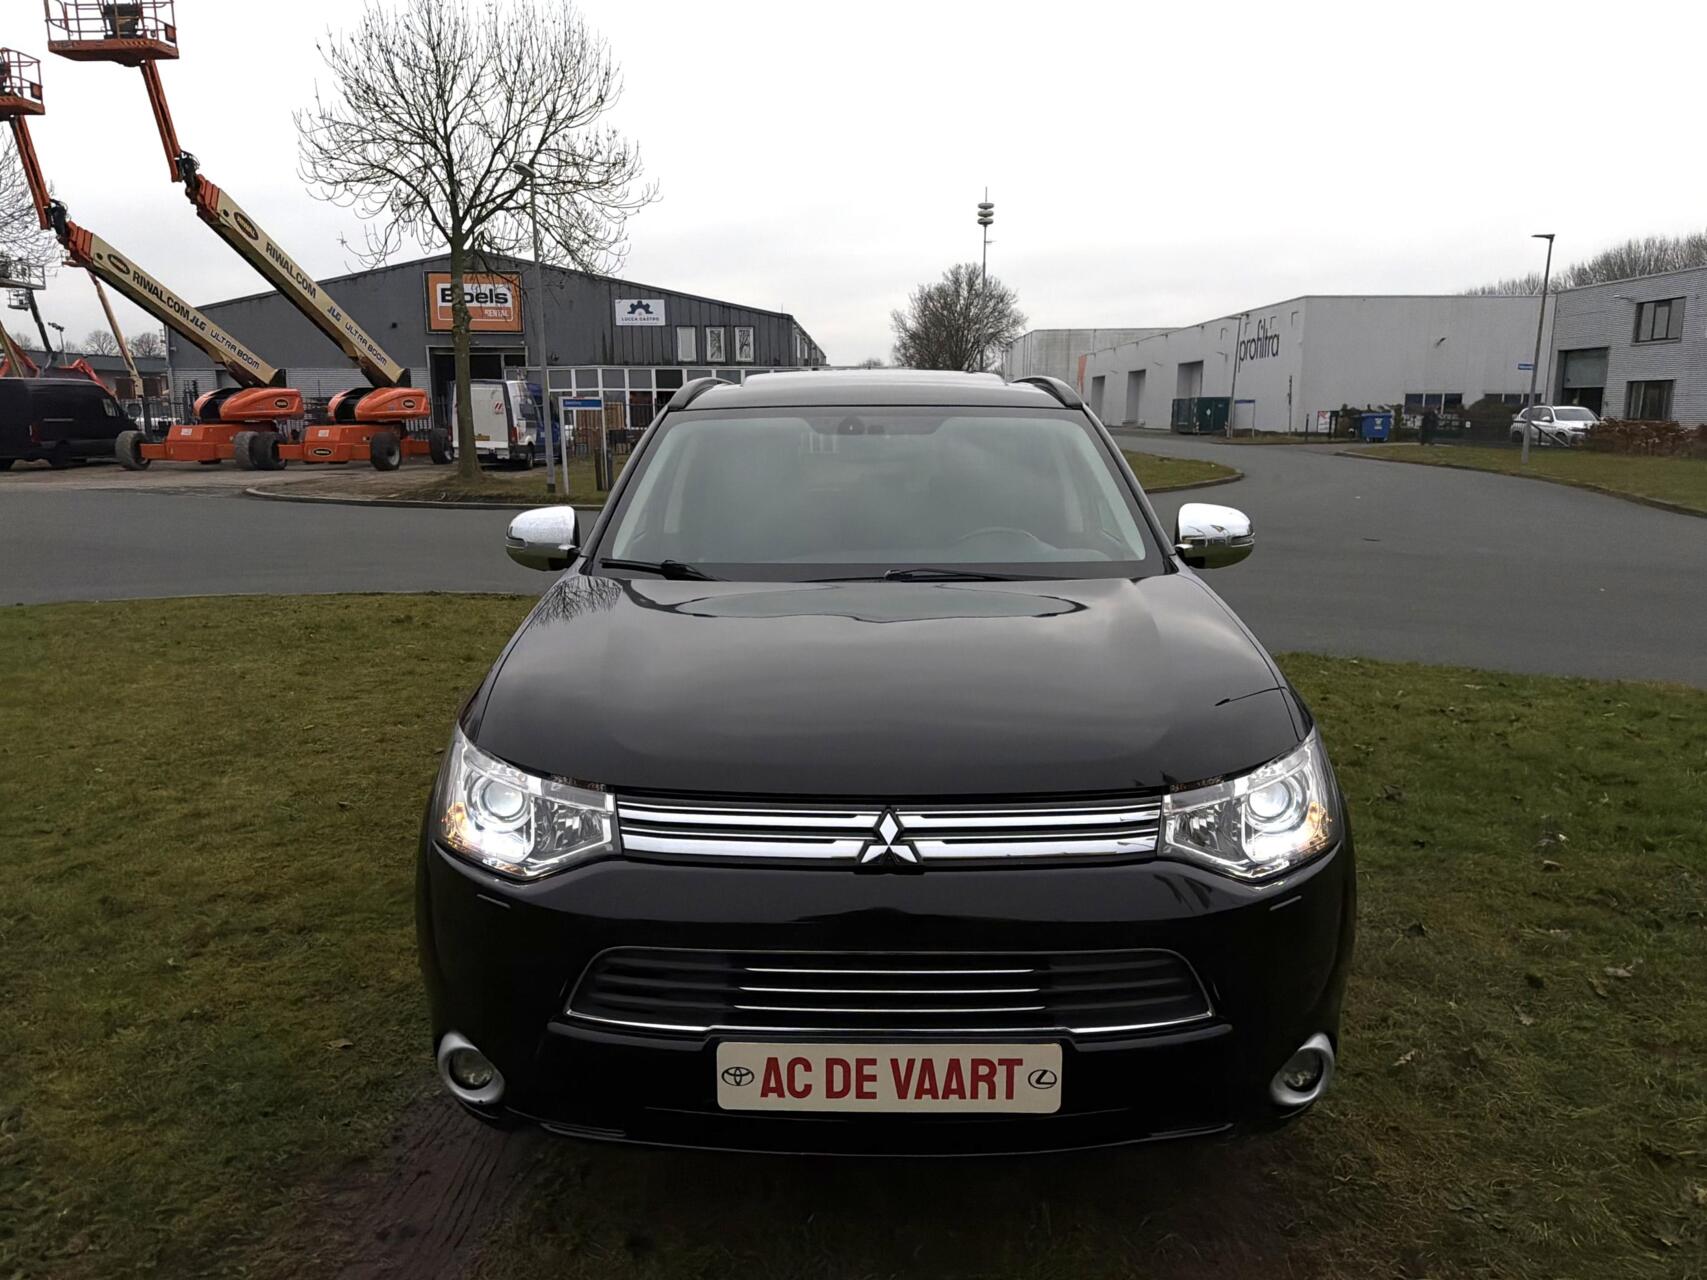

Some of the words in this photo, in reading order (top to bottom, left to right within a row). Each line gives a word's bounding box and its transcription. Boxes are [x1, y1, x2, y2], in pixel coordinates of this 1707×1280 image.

[190, 315, 207, 331] JLG
[326, 305, 342, 322] JLG
[210, 329, 237, 353] ULTRA
[236, 349, 260, 369] BOOM
[344, 322, 368, 347] ULTRA
[367, 343, 388, 366] BOOM
[1238, 318, 1280, 373] profiltra
[759, 1056, 813, 1099] AC
[825, 1057, 878, 1100] DE
[890, 1058, 1024, 1100] VAART
